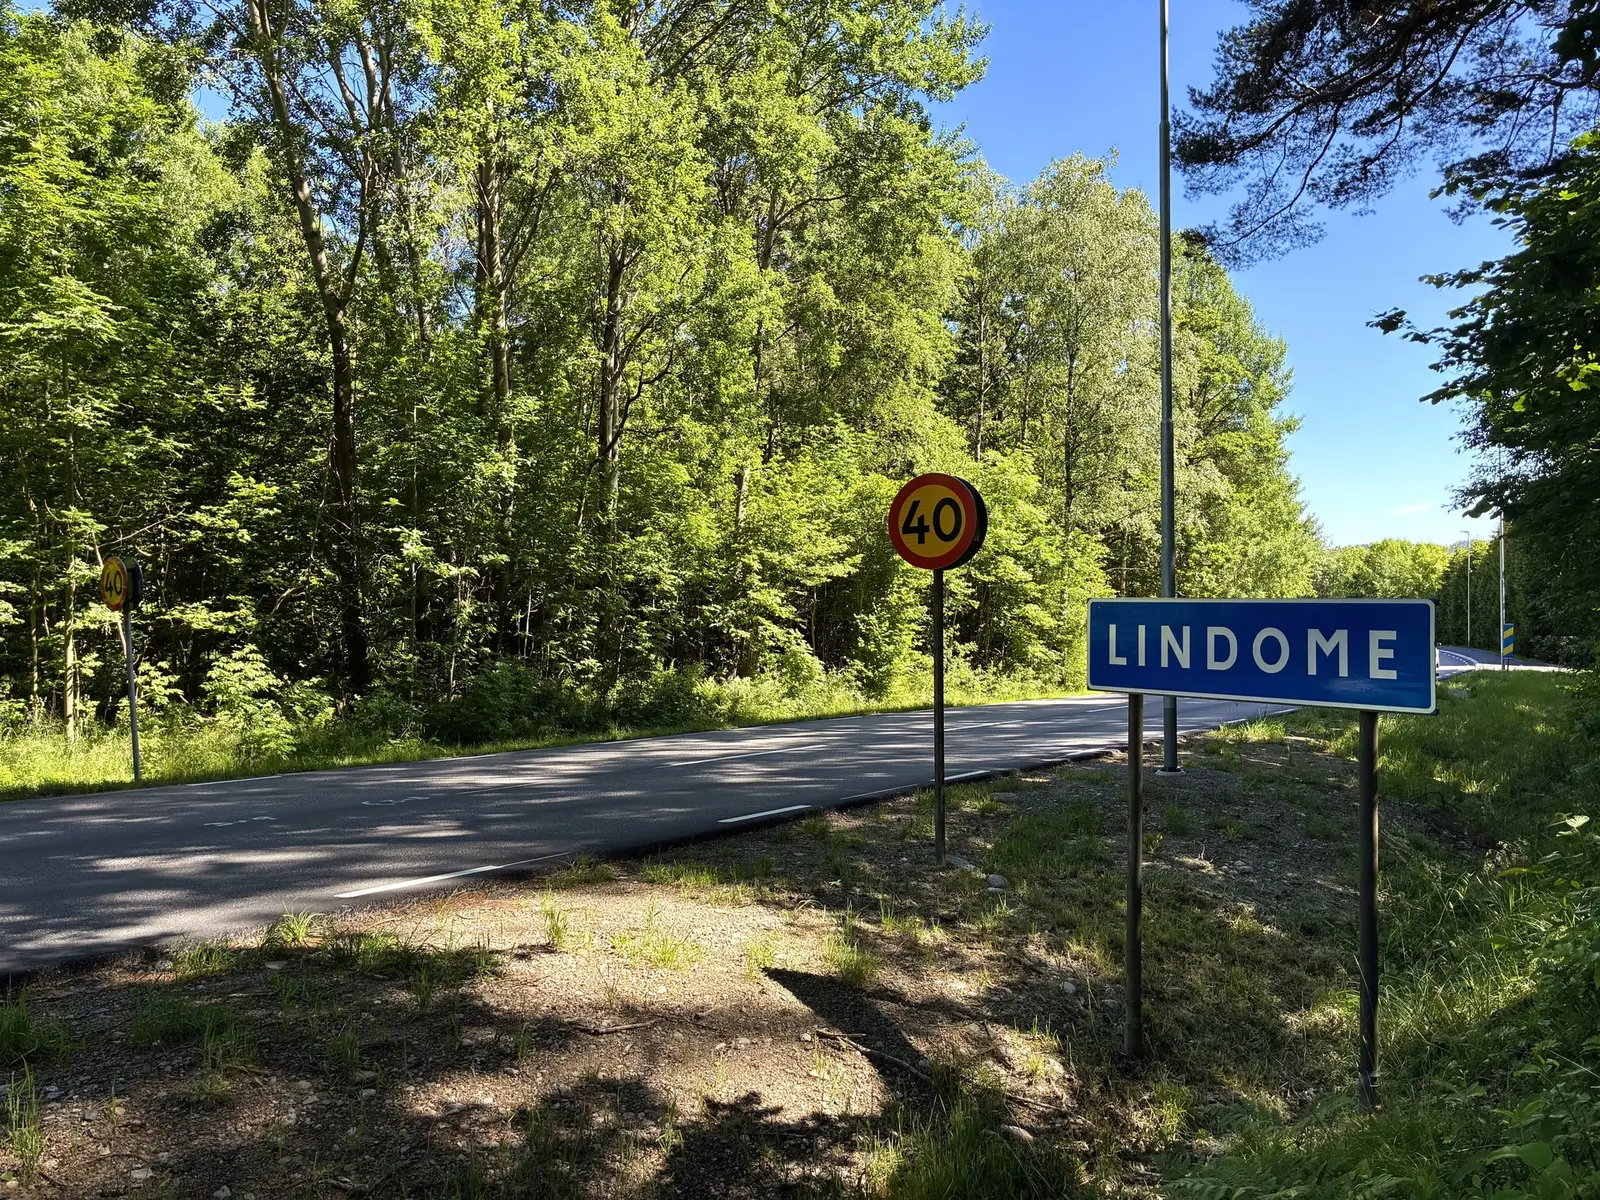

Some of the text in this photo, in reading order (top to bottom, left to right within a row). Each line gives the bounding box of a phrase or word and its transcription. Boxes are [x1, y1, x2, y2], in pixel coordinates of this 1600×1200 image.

[902, 497, 962, 544] 40
[105, 570, 123, 597] 40
[1109, 624, 1398, 680] LINDOME
